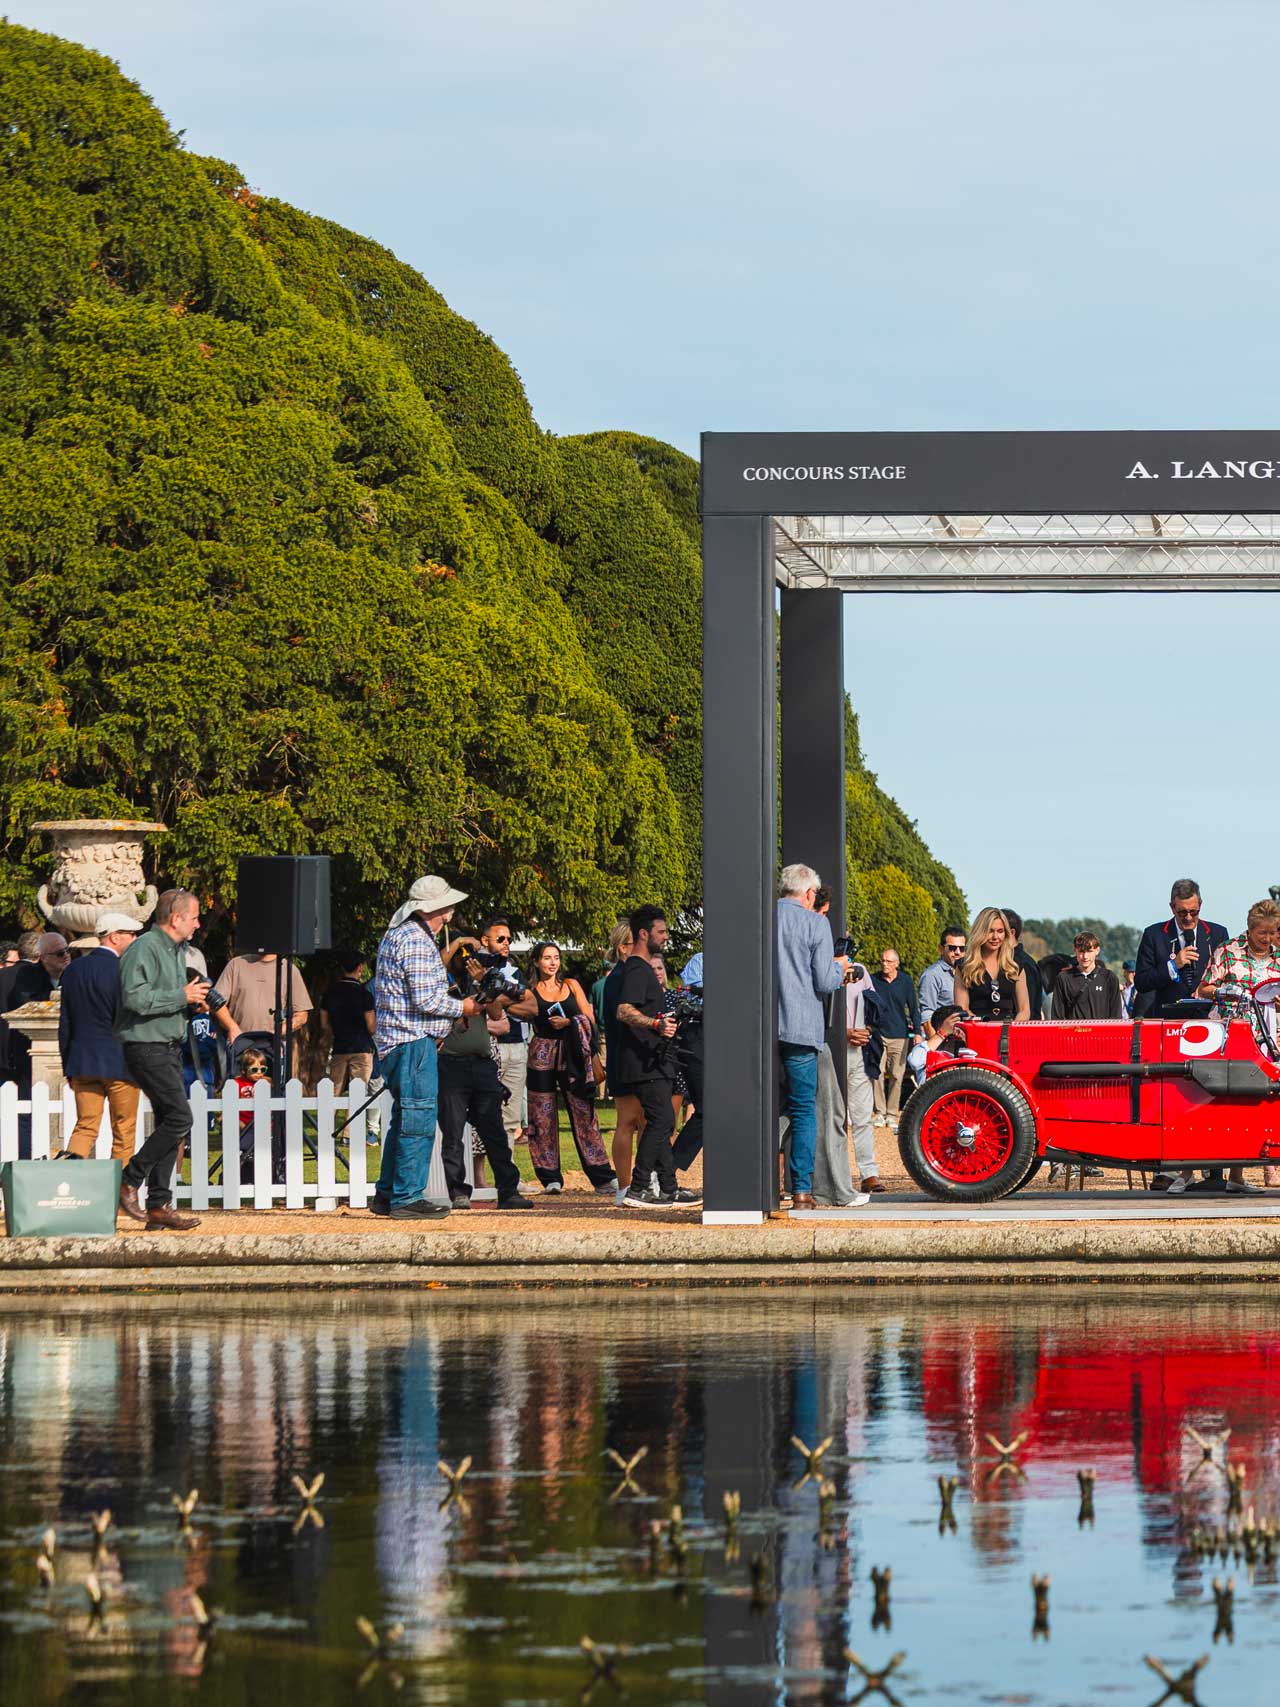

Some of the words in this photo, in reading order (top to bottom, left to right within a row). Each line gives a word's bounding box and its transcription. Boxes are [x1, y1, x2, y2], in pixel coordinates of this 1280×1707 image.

[743, 466, 844, 481] CONCOURS
[848, 466, 906, 480] STAGE
[1125, 461, 1159, 479] A.
[1166, 1028, 1187, 1037] LM17
